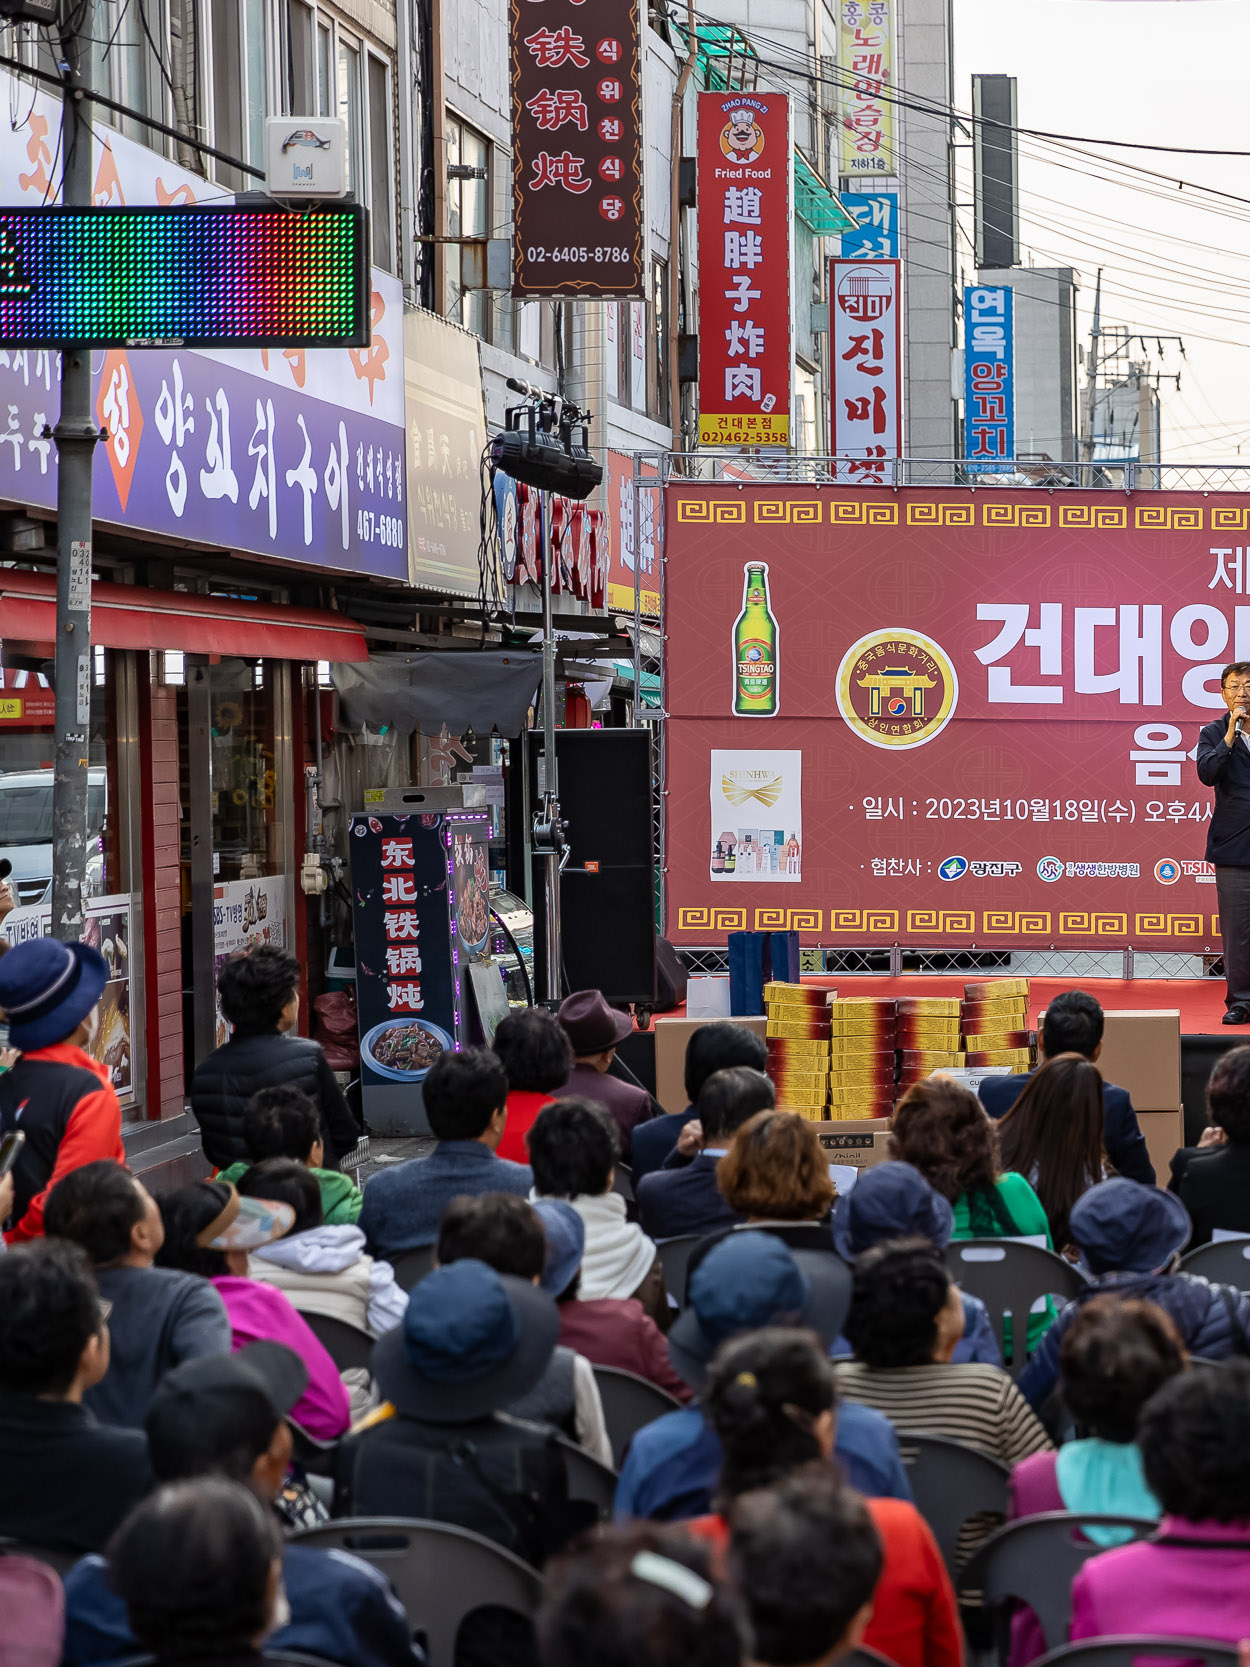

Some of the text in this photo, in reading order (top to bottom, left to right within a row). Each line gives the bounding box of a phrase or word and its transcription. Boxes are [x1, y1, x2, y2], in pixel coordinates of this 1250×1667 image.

[842, 2, 888, 26] 홍콩
[850, 29, 883, 153] 노래연습장
[525, 26, 593, 194] 铁锅炖
[721, 98, 743, 113] ZHAO
[742, 97, 760, 110] PANG
[600, 39, 623, 221] 식위천식당
[715, 167, 771, 180] Fried Food
[851, 158, 886, 170] 지하1층
[527, 246, 629, 263] 02-6405-8786
[723, 186, 765, 402] 趙胖子炸肉
[844, 296, 887, 317] 진미
[971, 362, 1007, 456] 양꼬치
[717, 416, 772, 430] 건대본점
[702, 431, 787, 443] 02)462-5358
[154, 358, 350, 550] 양꼬치구이
[357, 509, 403, 549] 467-6880
[857, 643, 937, 672] 중국음식문화거리
[738, 664, 774, 673] TSINGTAO
[868, 719, 924, 735] 상인연합회
[729, 770, 776, 779] SHINHWA
[862, 796, 905, 821] 일시
[925, 797, 1137, 825] 2023년10월18일(수)
[870, 857, 923, 877] 협찬사
[969, 860, 1023, 877] 광진구
[1075, 862, 1140, 877] 생생한방병원
[381, 840, 424, 1010] 东北铁锅炖
